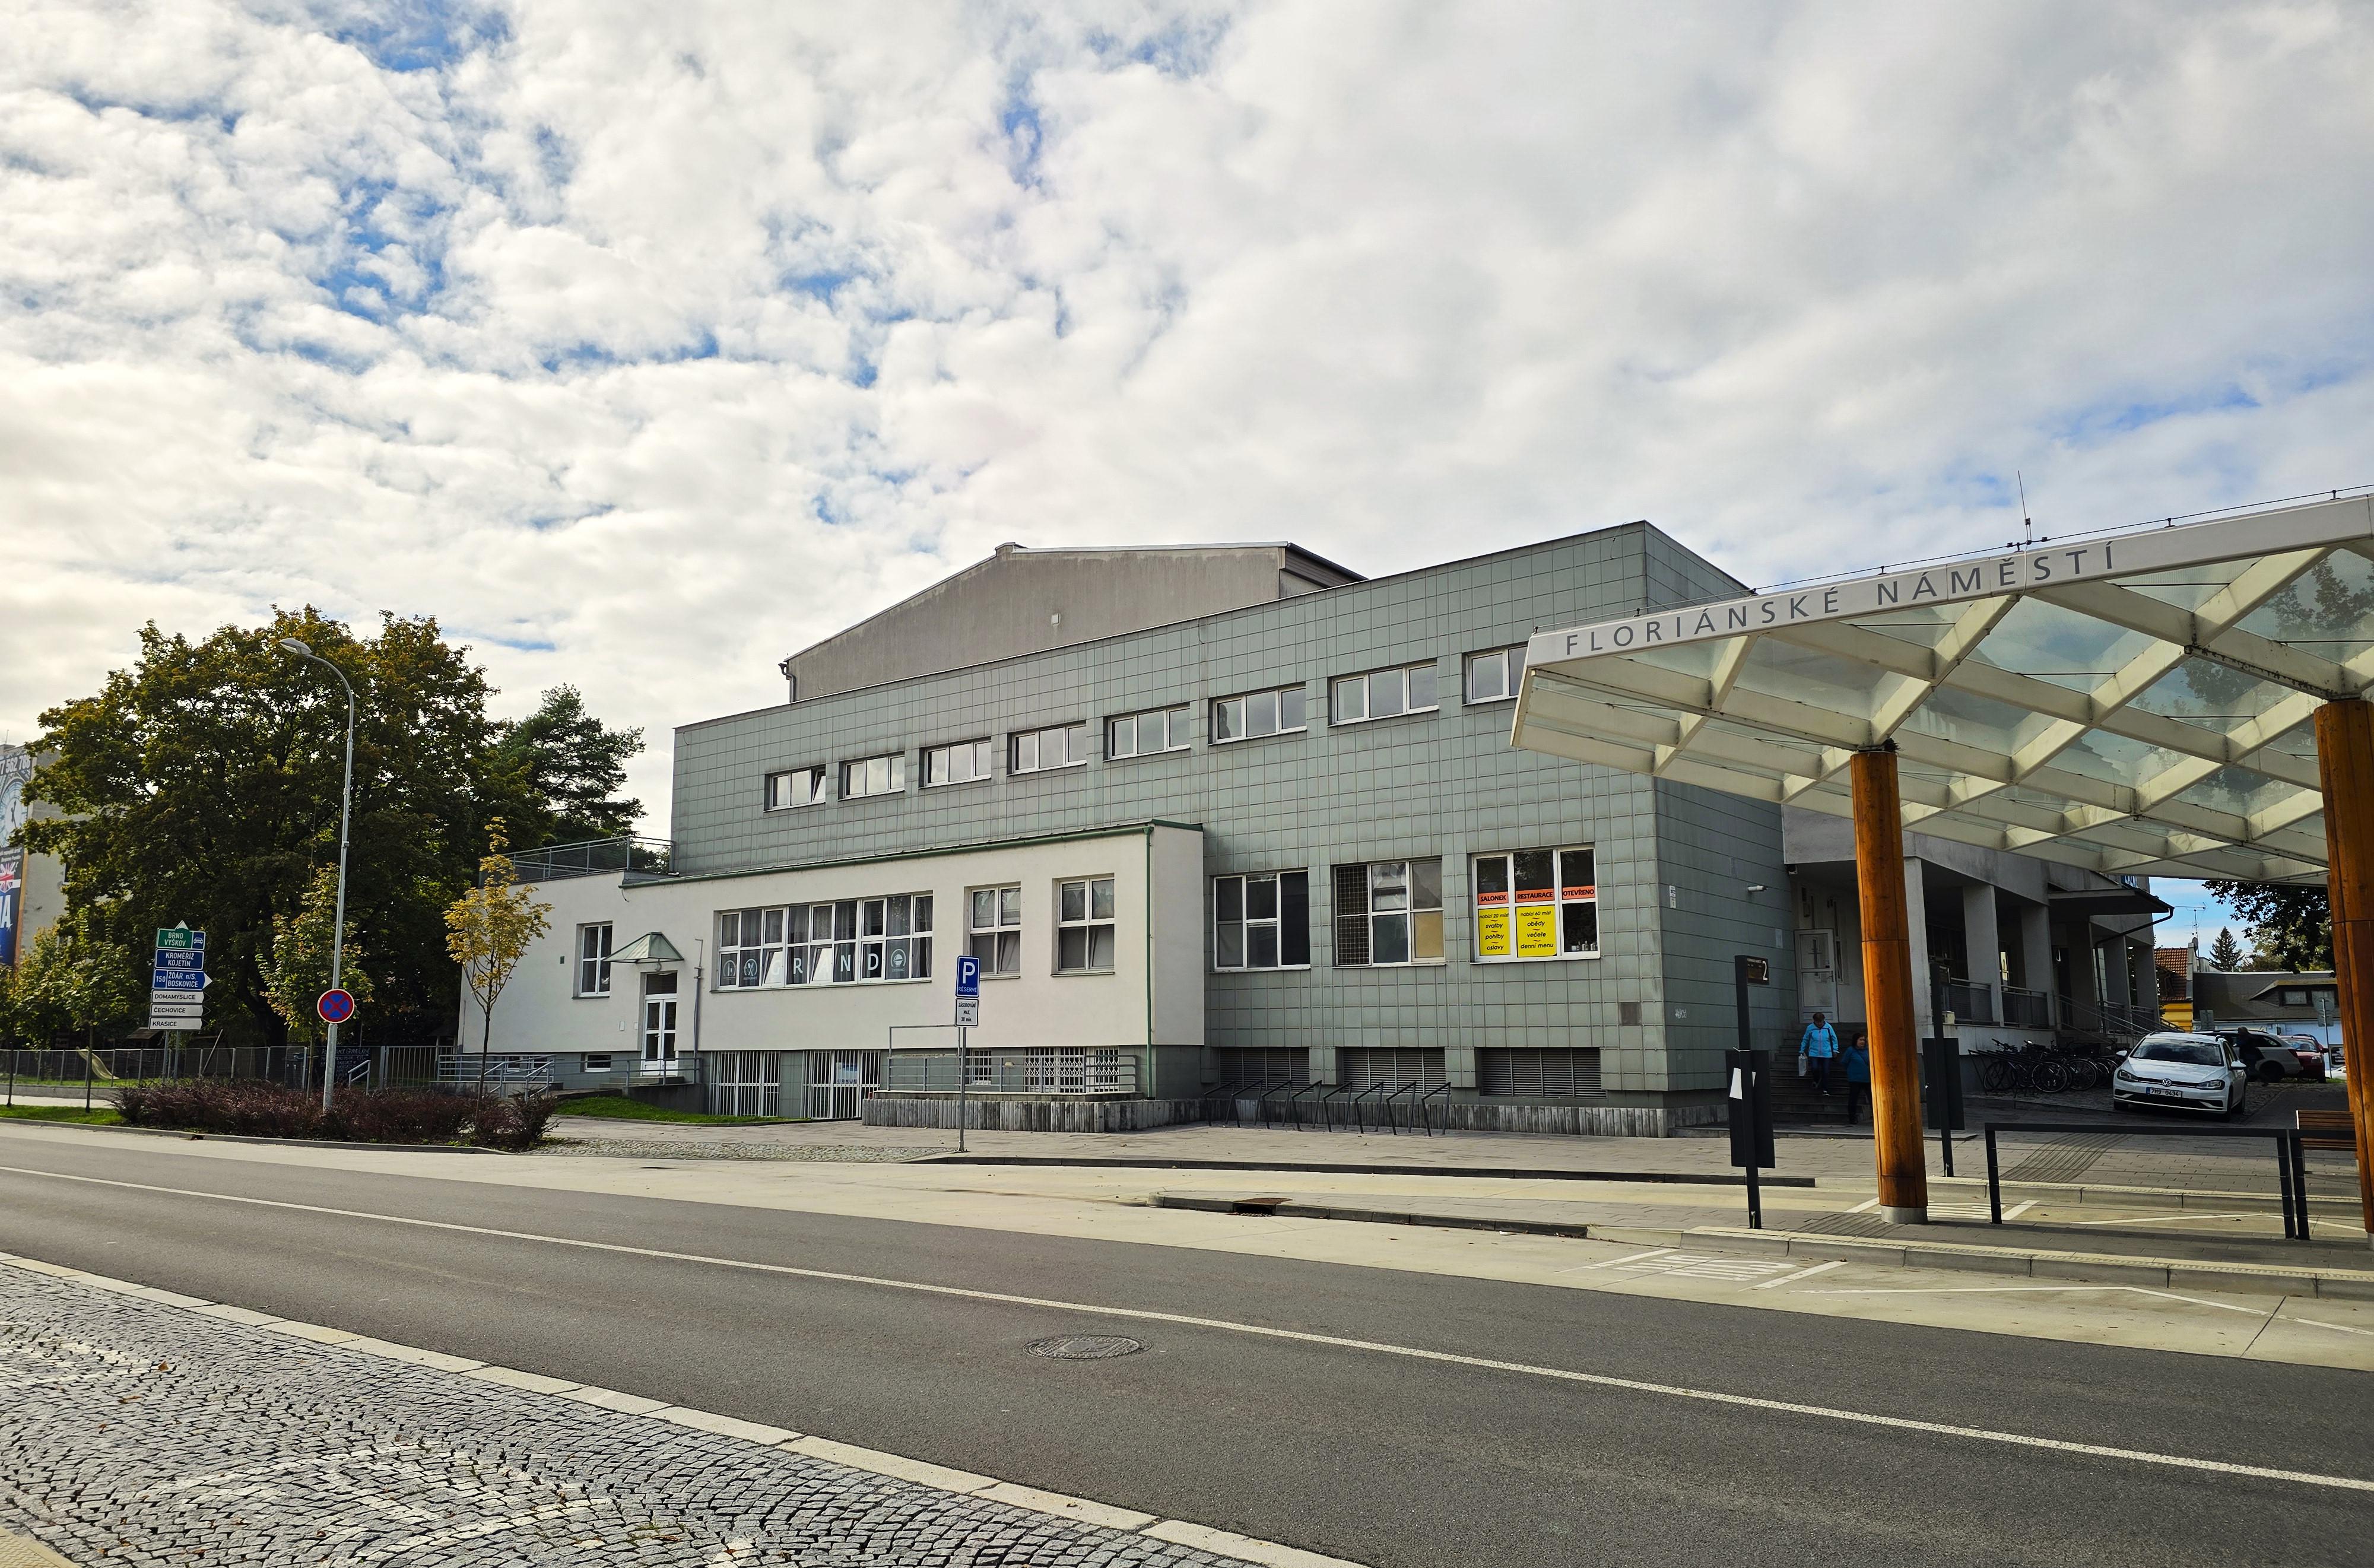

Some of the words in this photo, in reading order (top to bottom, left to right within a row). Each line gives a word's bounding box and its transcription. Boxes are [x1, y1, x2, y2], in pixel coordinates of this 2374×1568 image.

[1566, 585, 1839, 656] FLORIÁNSKÉ
[1877, 539, 2113, 607] NÁMĚSTÍ
[6, 757, 18, 773] 562
[1517, 891, 1553, 900] RESTAURACE
[1563, 888, 1595, 897] OTEVŘENO
[164, 938, 186, 947] VYŠKOV
[166, 952, 195, 960] KROMĚŘÍŽ
[168, 971, 183, 979] ŽĎÁR
[962, 961, 976, 984] P
[1762, 960, 1768, 981] 2
